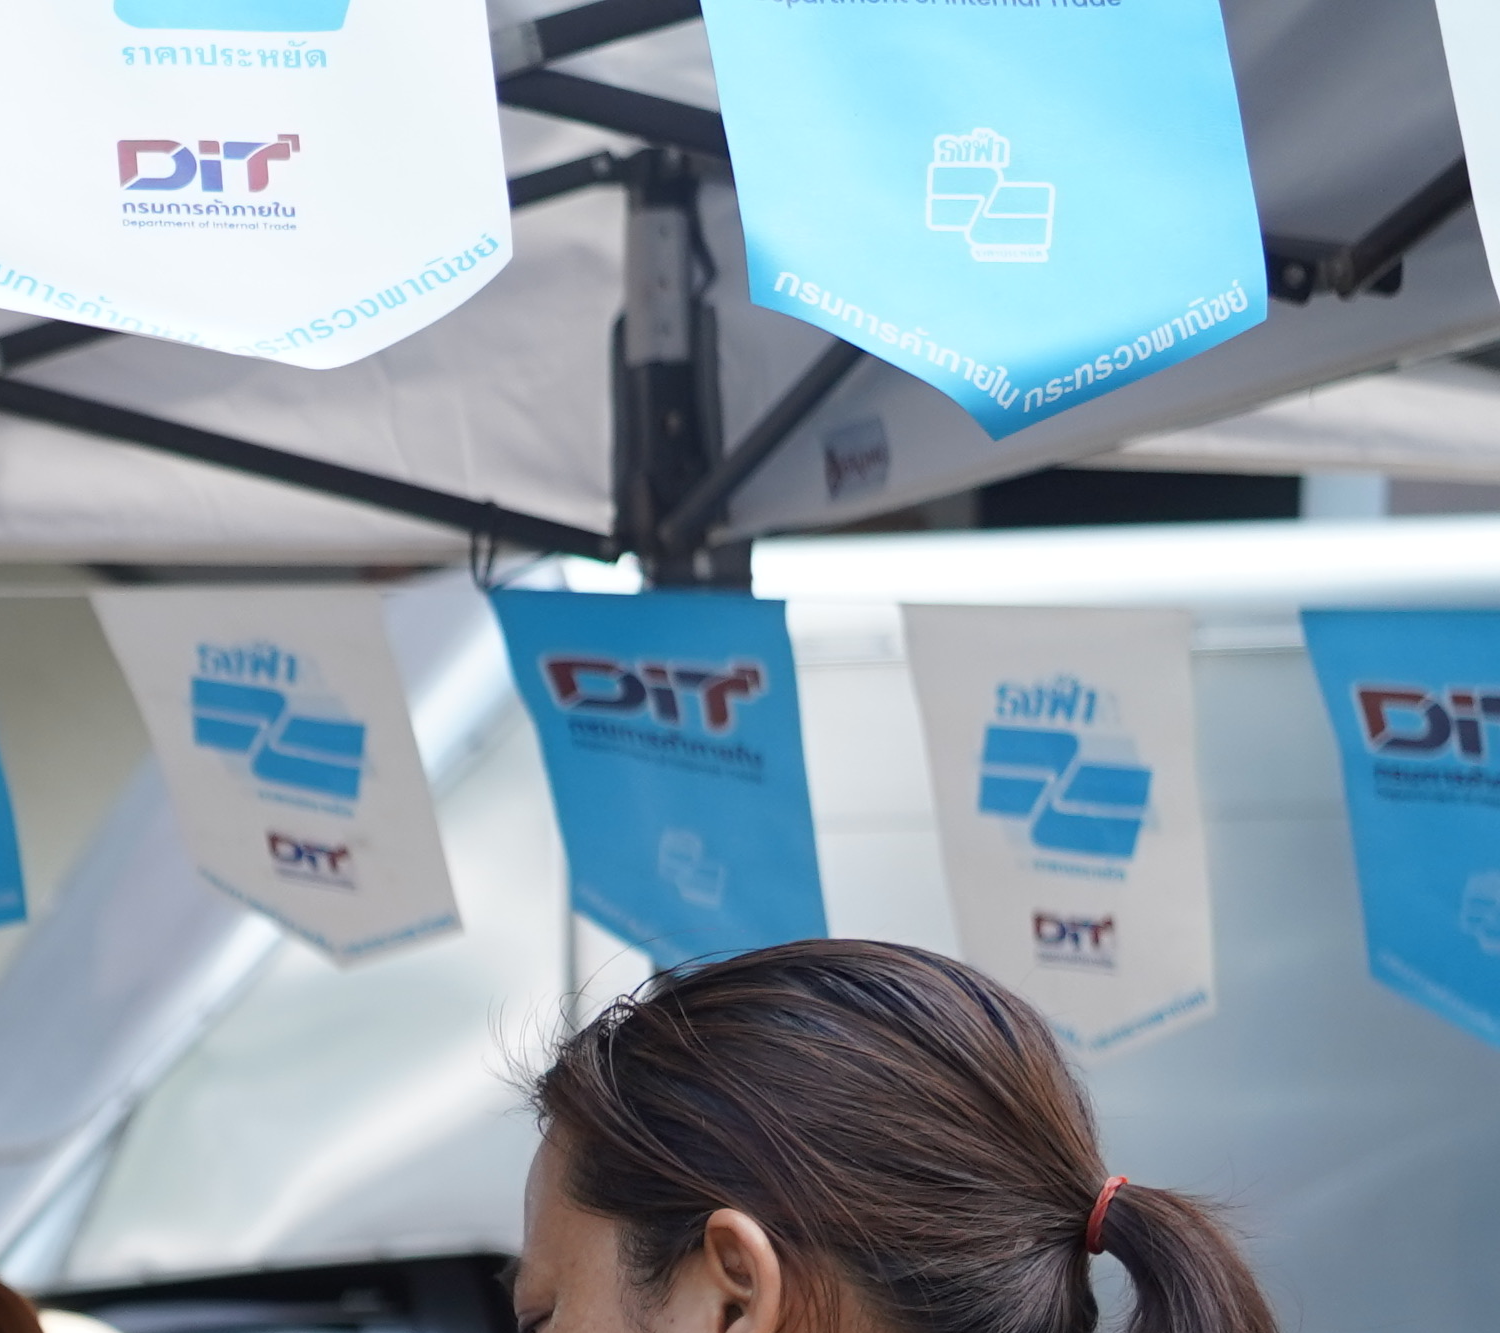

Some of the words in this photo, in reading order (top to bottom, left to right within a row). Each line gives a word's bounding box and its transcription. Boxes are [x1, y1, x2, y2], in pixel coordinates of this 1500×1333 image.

[121, 40, 328, 69] ราคาประหยัด
[121, 199, 297, 219] กรมการค้าภายใน
[122, 218, 195, 230] Department
[199, 220, 210, 230] of
[212, 221, 259, 231] Internal
[262, 222, 297, 231] Trade
[772, 270, 1020, 410] กรมการค้าภายใน
[1023, 279, 1248, 413] กระทรวงพาณิชย์
